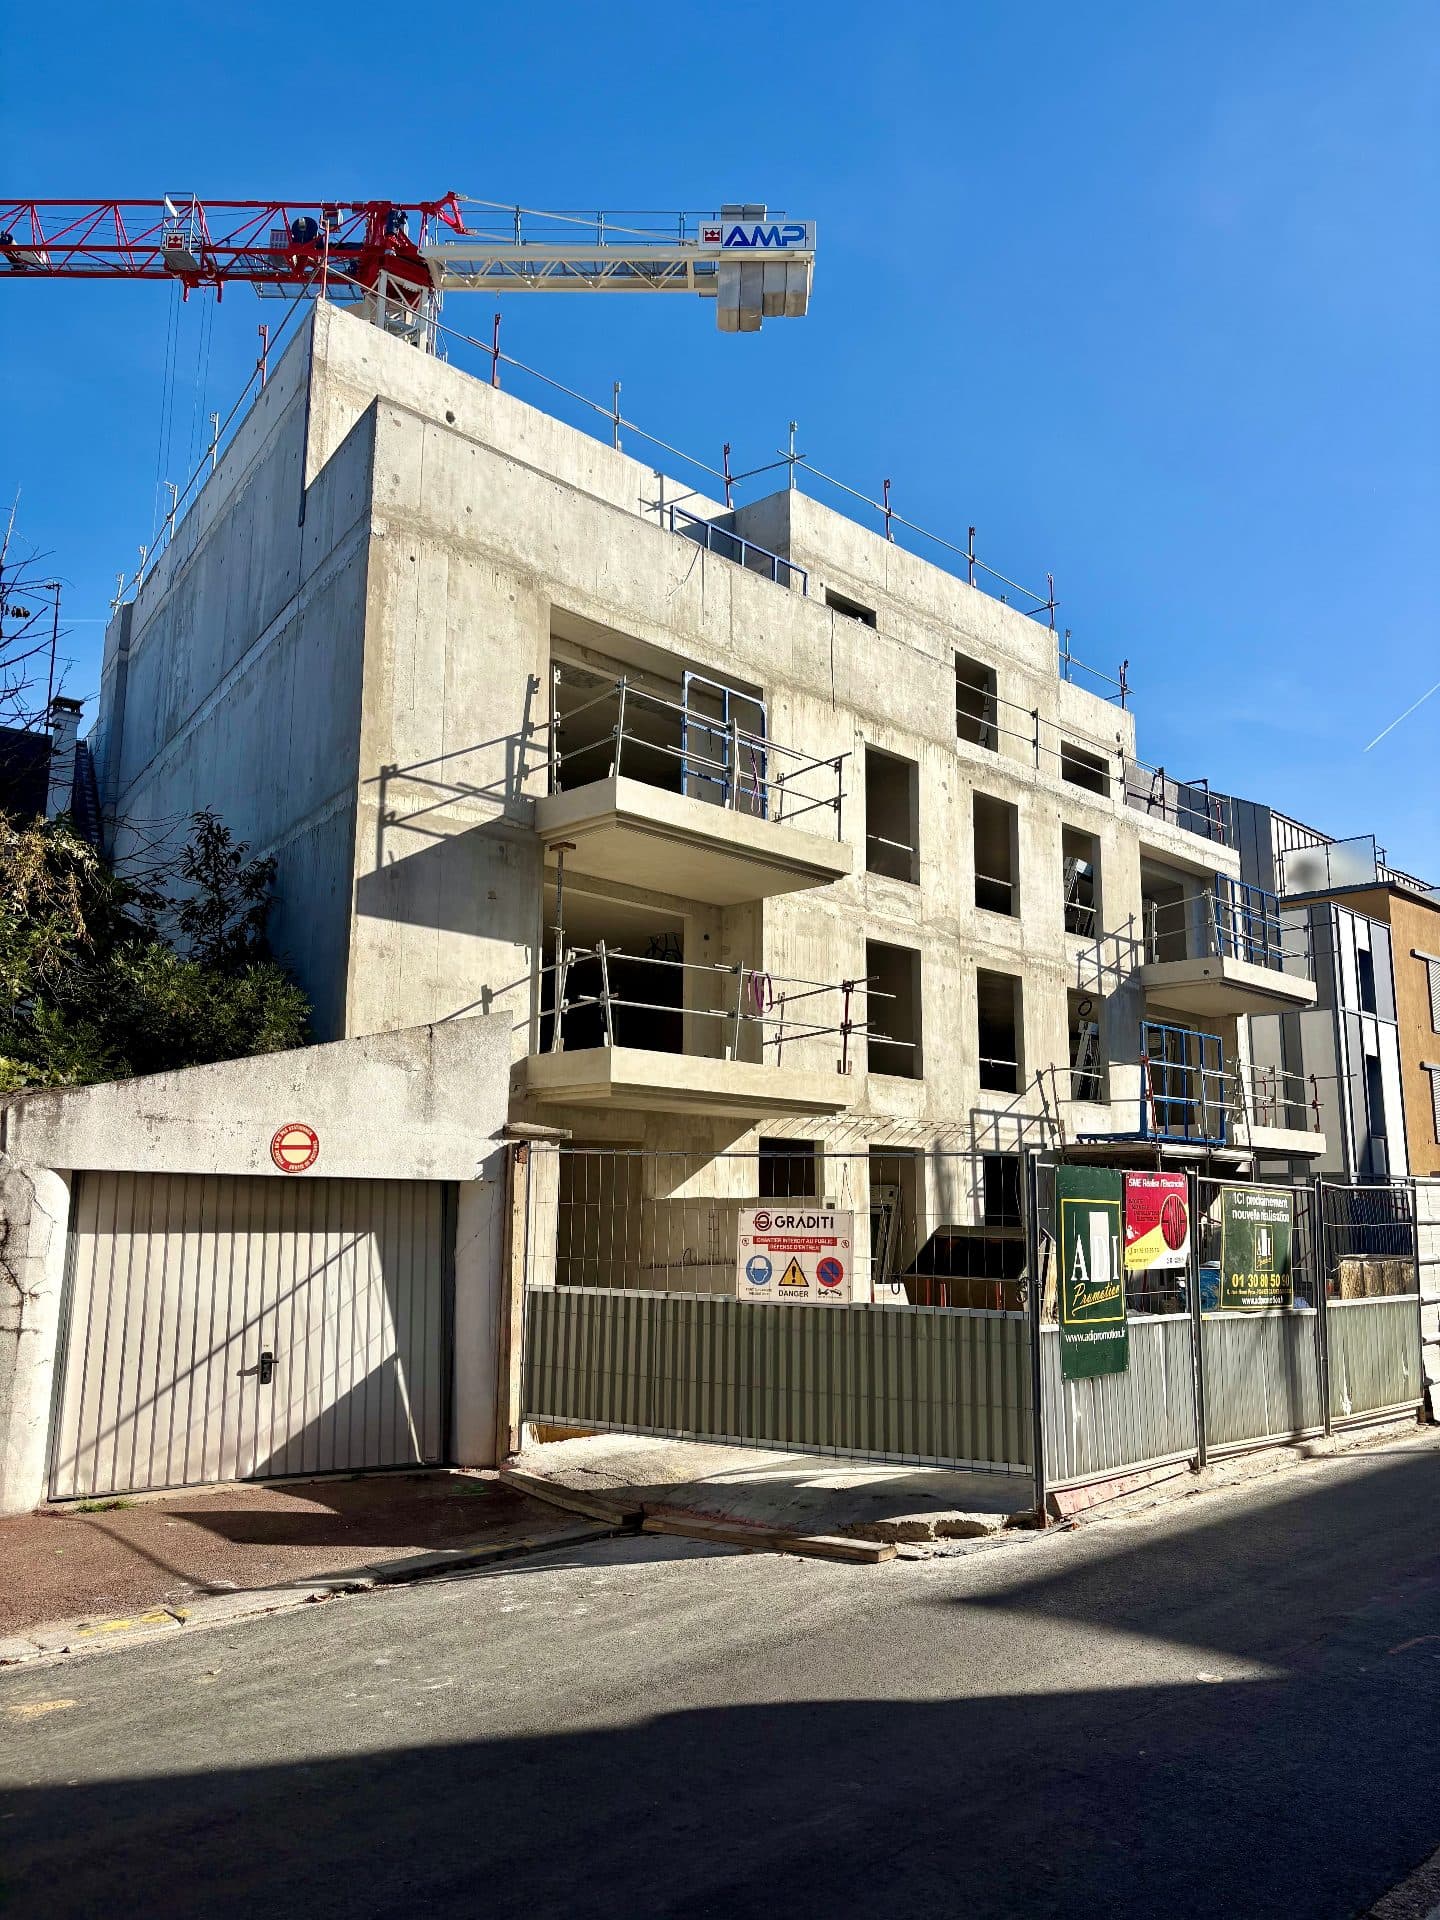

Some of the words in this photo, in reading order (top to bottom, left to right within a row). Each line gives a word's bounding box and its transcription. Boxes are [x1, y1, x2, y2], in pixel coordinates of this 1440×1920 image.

[723, 225, 805, 246] AMP
[1233, 1192, 1245, 1205] ICI
[774, 1216, 834, 1229] GRADITI
[1232, 1274, 1244, 1287] 01
[1248, 1274, 1258, 1287] 30
[1270, 1274, 1280, 1287] 50
[779, 1290, 809, 1298] DANGER
